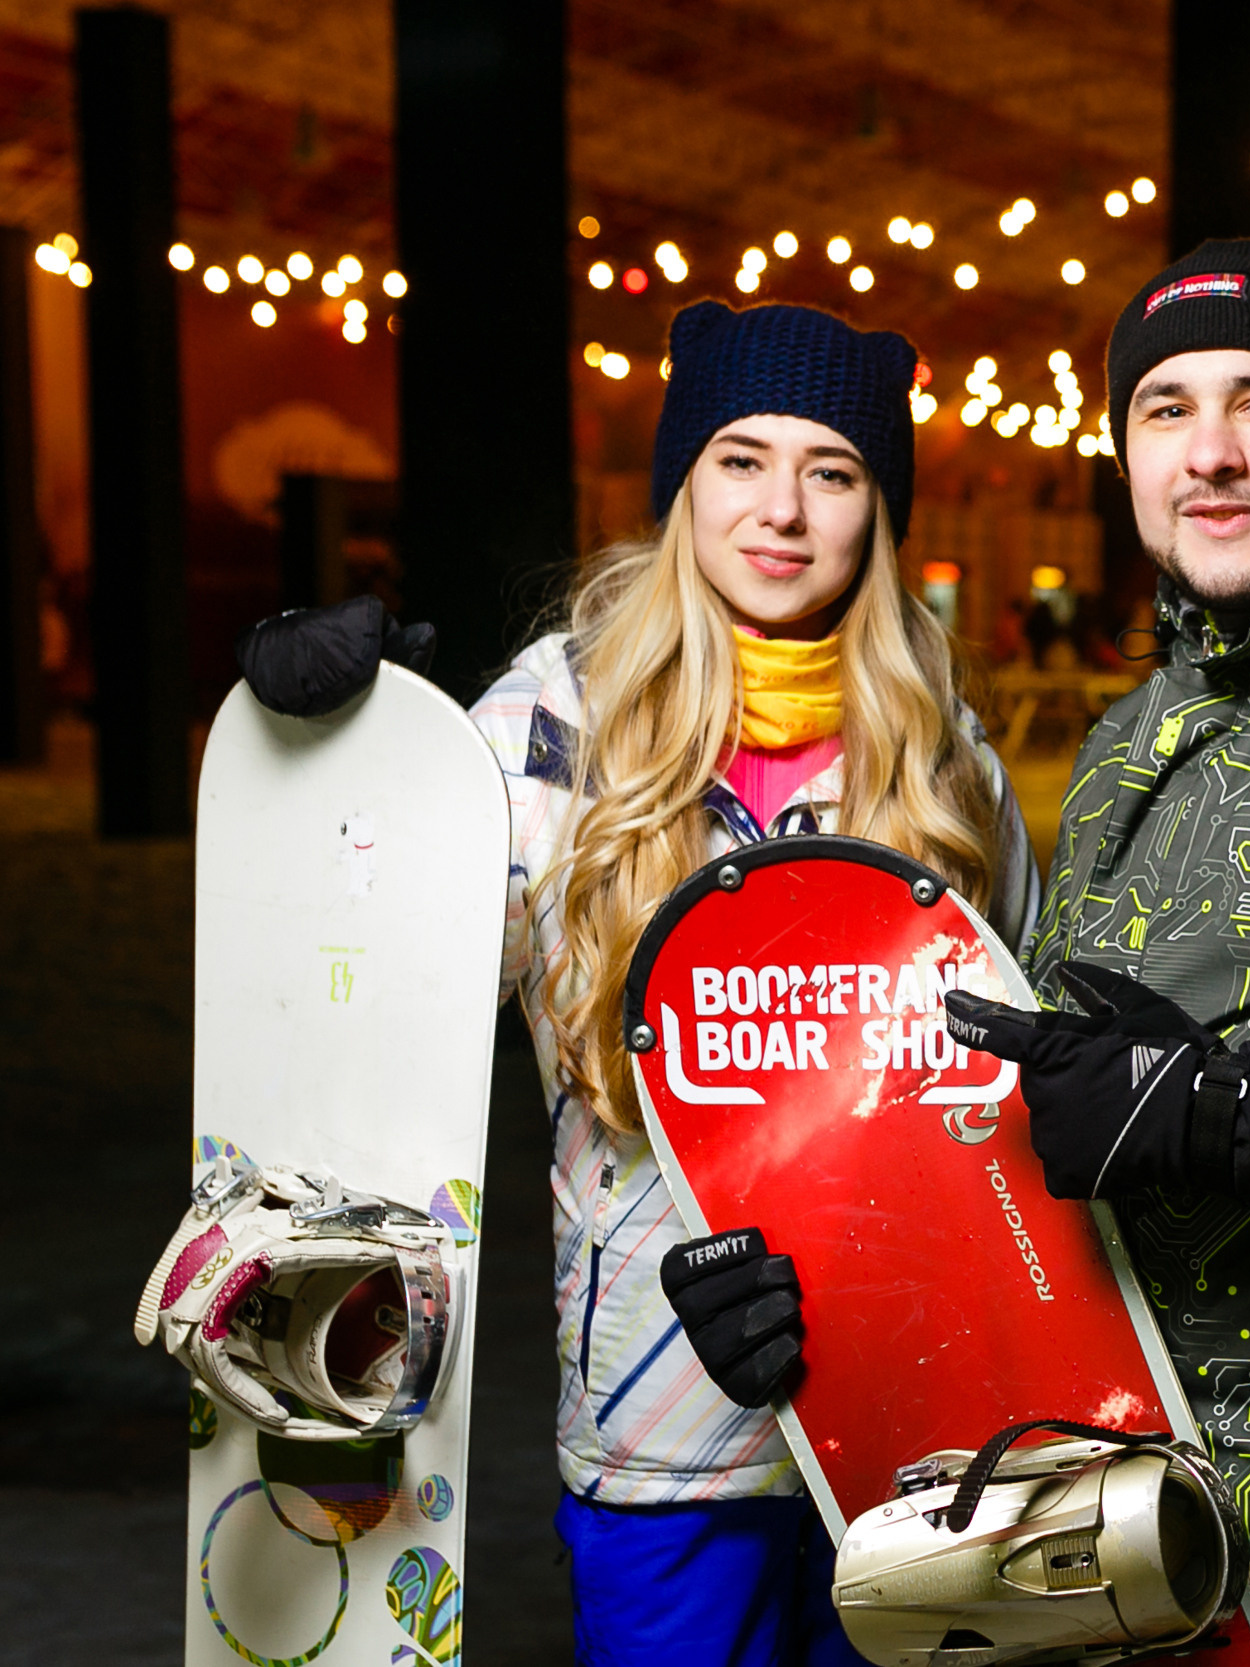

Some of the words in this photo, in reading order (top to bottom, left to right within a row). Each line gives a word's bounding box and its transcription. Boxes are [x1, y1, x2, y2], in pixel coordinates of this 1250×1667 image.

[1184, 280, 1240, 294] NOTHING
[696, 1020, 829, 1071] BOAR
[985, 1158, 1055, 1301] ROSSIGNOL
[683, 1235, 750, 1268] TERM'IT
